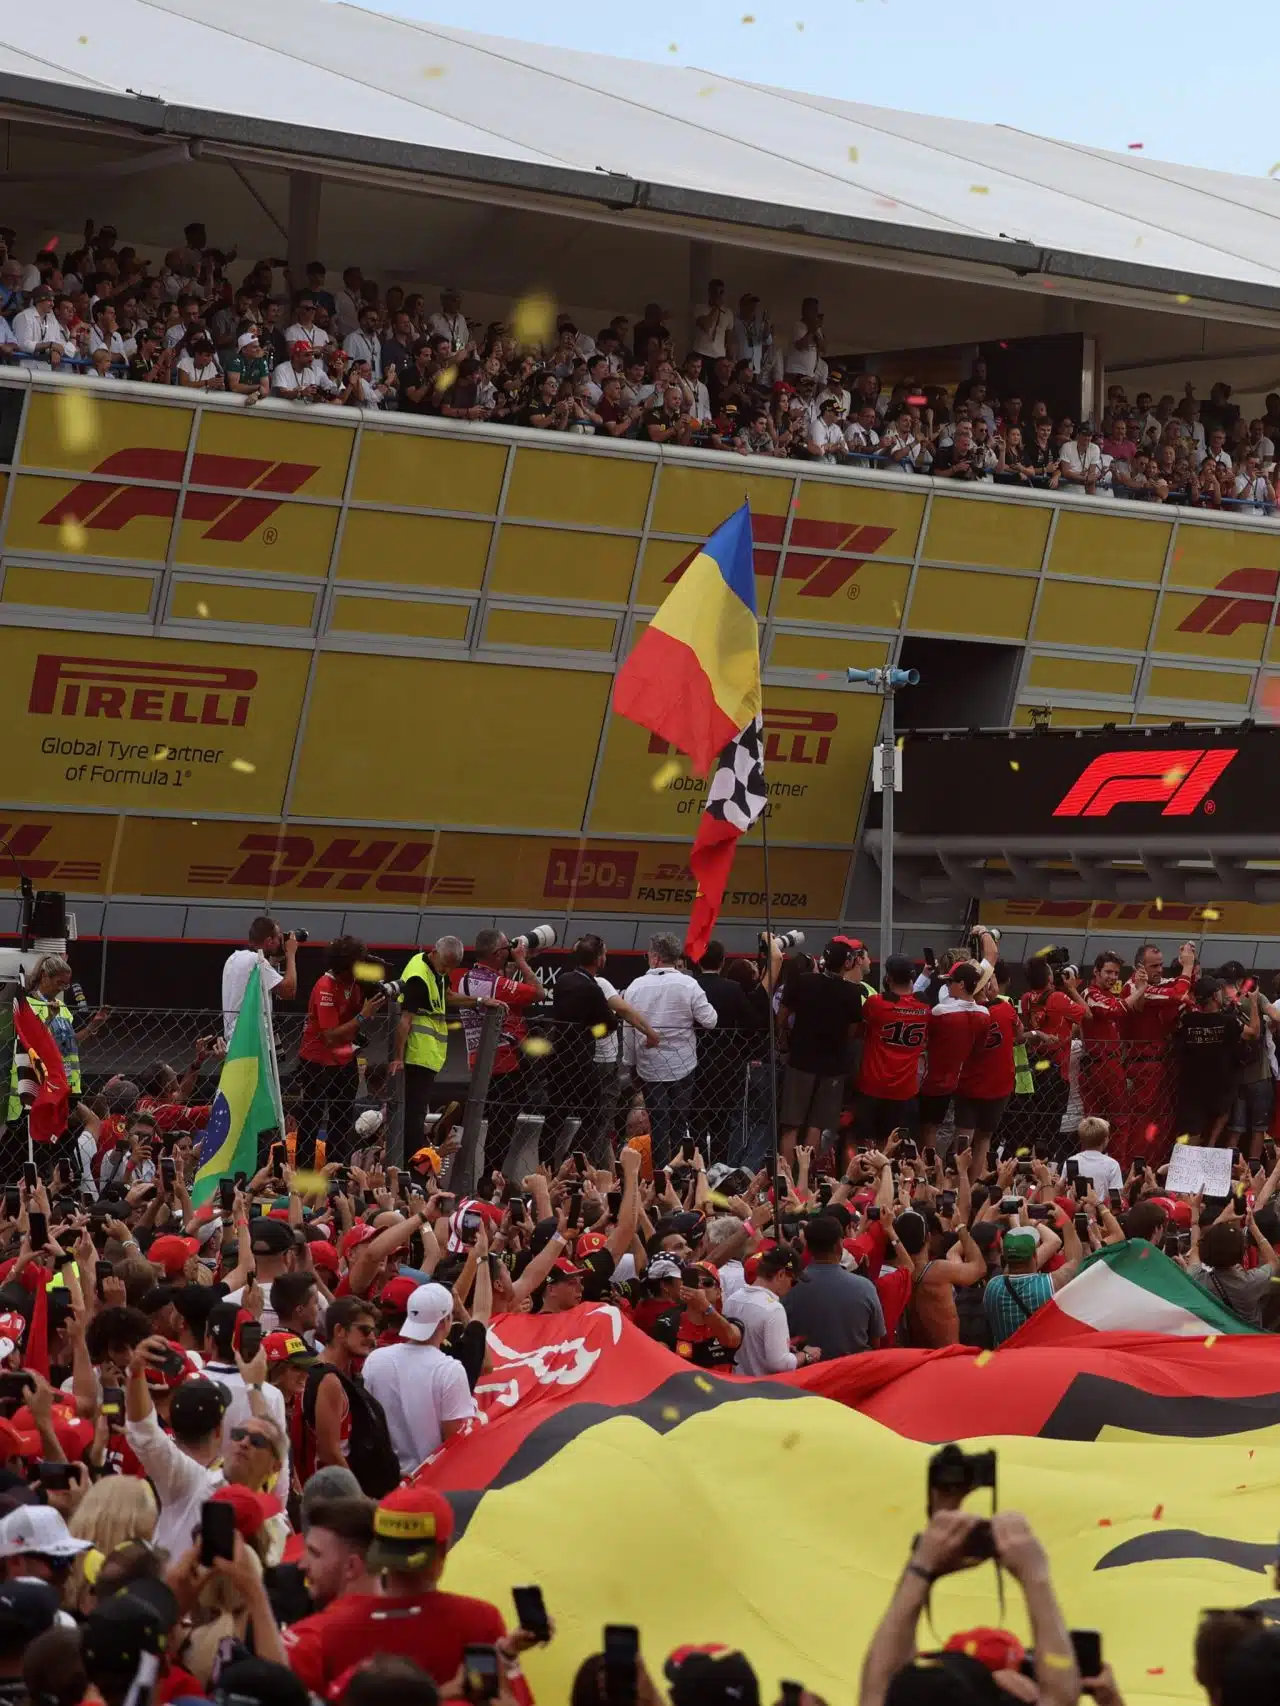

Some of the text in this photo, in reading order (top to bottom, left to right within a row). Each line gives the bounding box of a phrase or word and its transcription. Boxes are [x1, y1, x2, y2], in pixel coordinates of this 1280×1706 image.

[38, 447, 321, 542] F1
[28, 654, 258, 728] PIRELLI
[41, 737, 102, 757] Global
[107, 740, 149, 764] Tyre
[65, 764, 87, 783] of
[90, 765, 168, 786] Formula
[660, 776, 808, 797] lobal artner
[1052, 749, 1239, 816] F1
[677, 799, 694, 814] of
[227, 833, 435, 894] DHL
[637, 887, 696, 903] FASTES
[772, 893, 808, 907] 2024
[880, 1020, 927, 1048] 16
